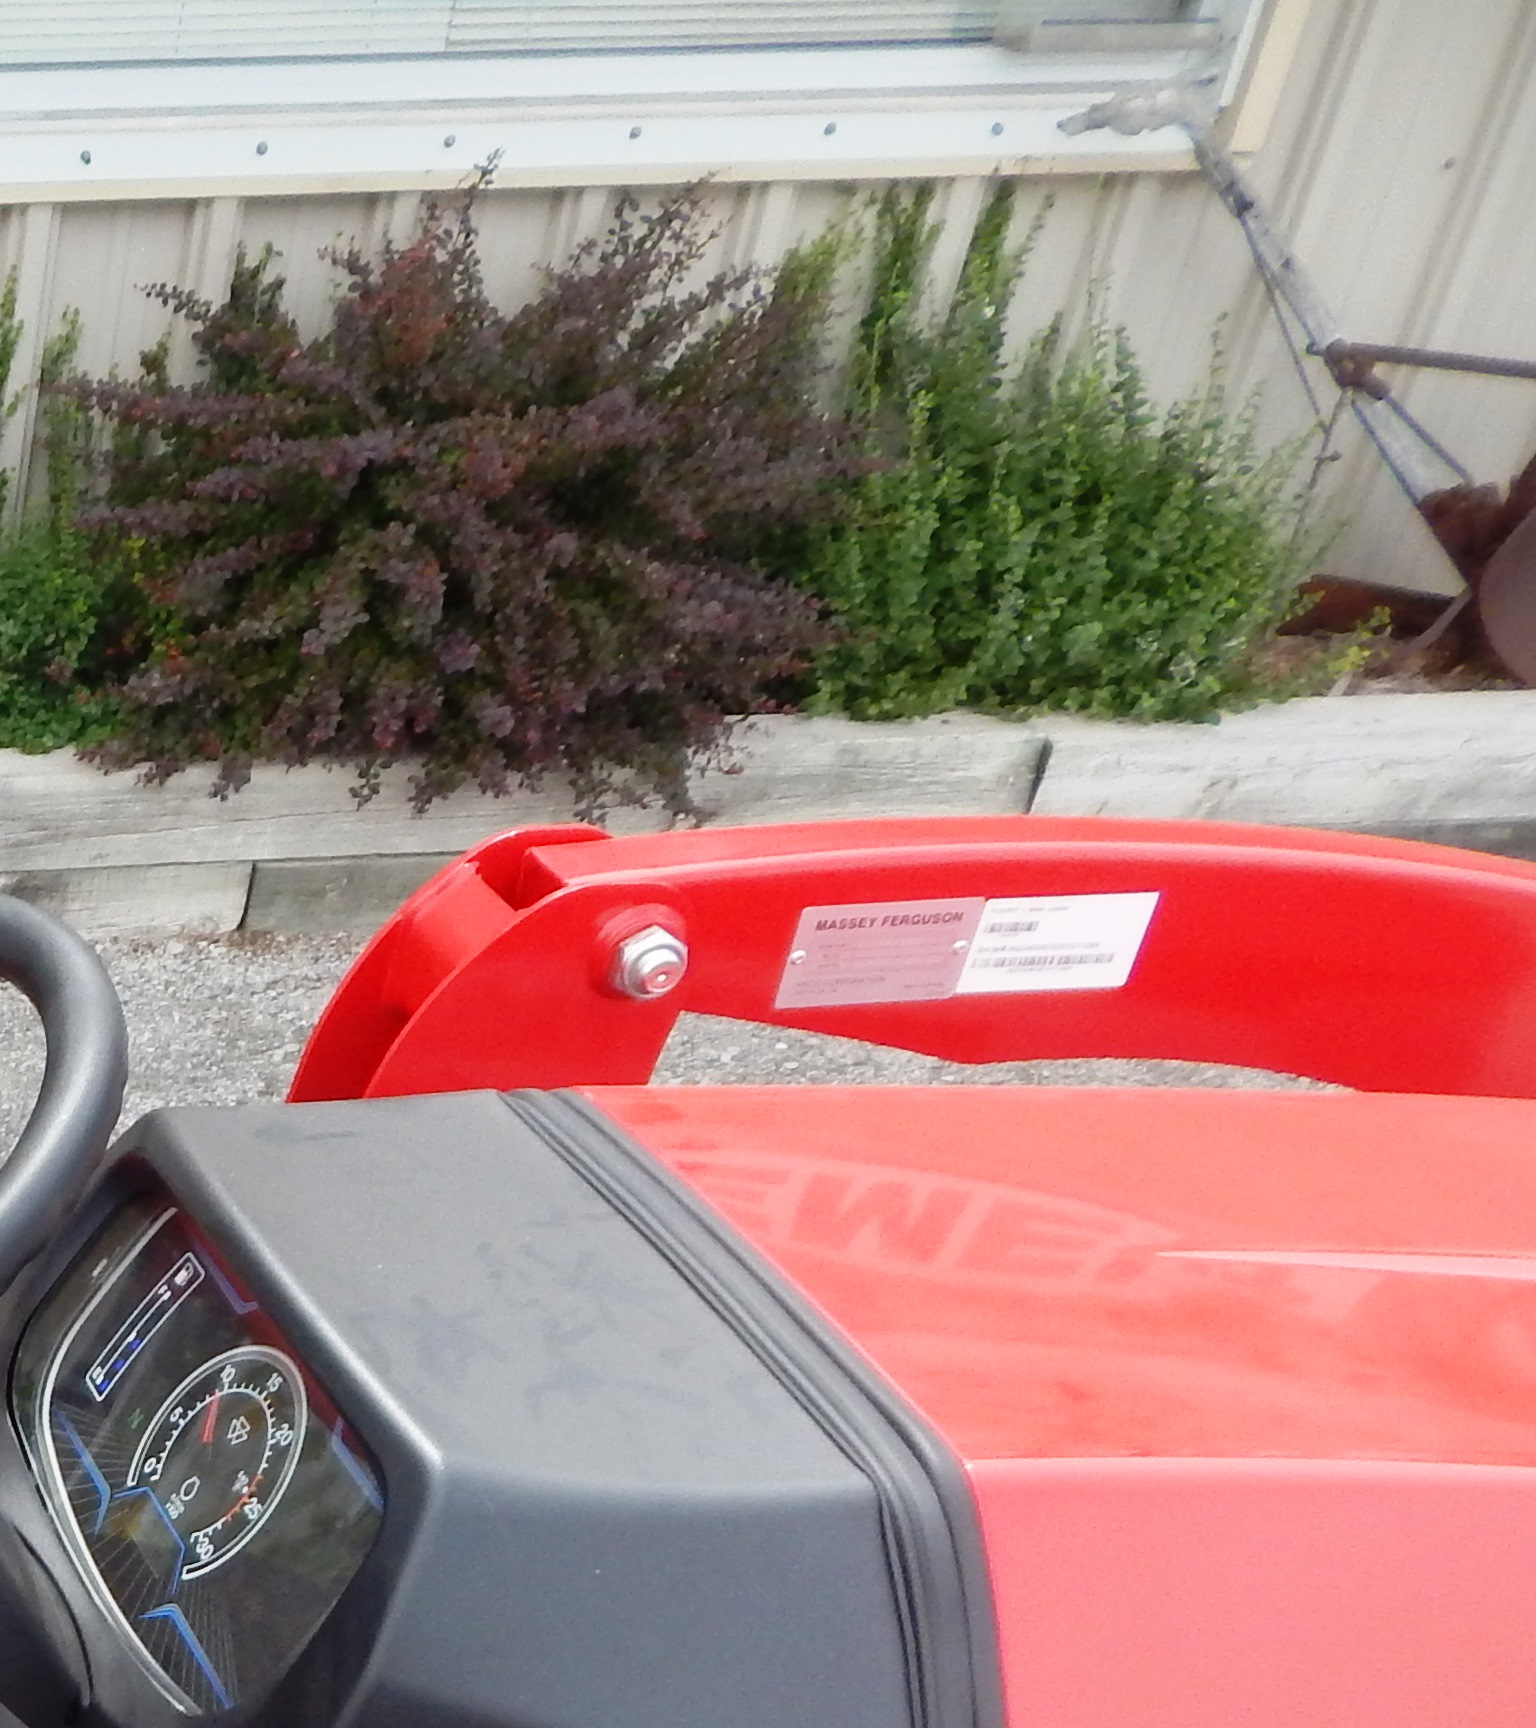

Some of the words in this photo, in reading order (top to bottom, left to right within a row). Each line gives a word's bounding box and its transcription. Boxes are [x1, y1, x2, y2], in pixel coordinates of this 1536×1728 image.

[814, 916, 879, 932] MASSEY
[880, 911, 965, 928] FERGUSON
[220, 1364, 236, 1384] 10
[268, 1372, 284, 1392] 15
[274, 1423, 294, 1446] 20
[143, 1457, 158, 1474] 0
[243, 1497, 263, 1520] 25
